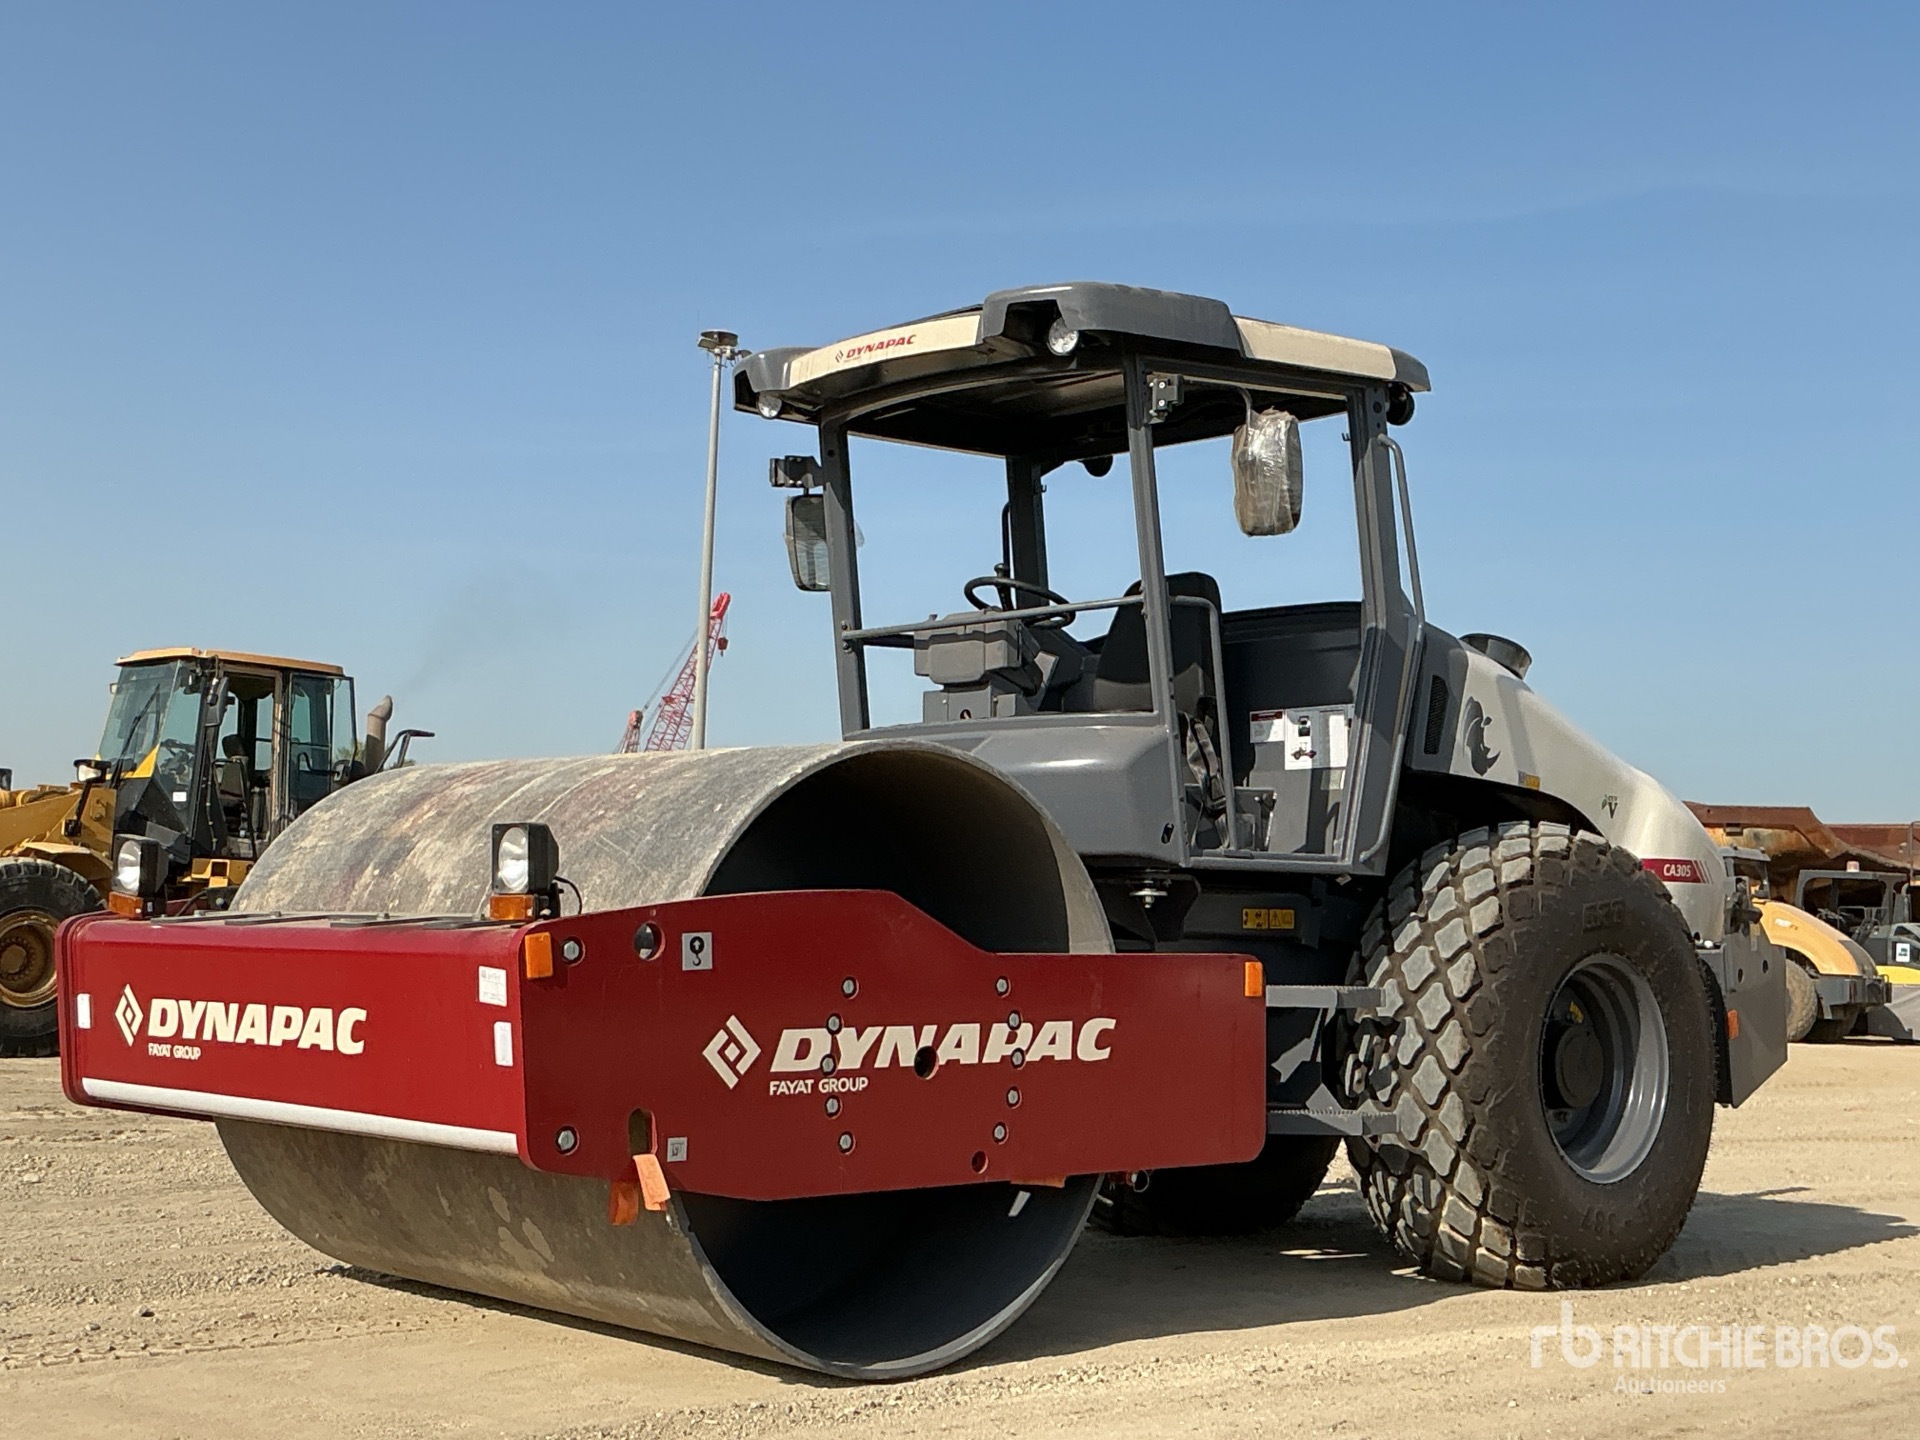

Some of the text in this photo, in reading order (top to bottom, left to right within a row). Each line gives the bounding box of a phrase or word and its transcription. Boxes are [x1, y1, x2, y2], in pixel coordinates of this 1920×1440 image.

[846, 334, 916, 359] DYNAPAC
[1663, 863, 1691, 877] CA305
[148, 998, 367, 1055] DYNAPAC
[148, 1042, 202, 1060] FAYAT GROUP
[770, 1017, 1116, 1073] DYNAPAC
[769, 1076, 869, 1096] FAYAT GROUP
